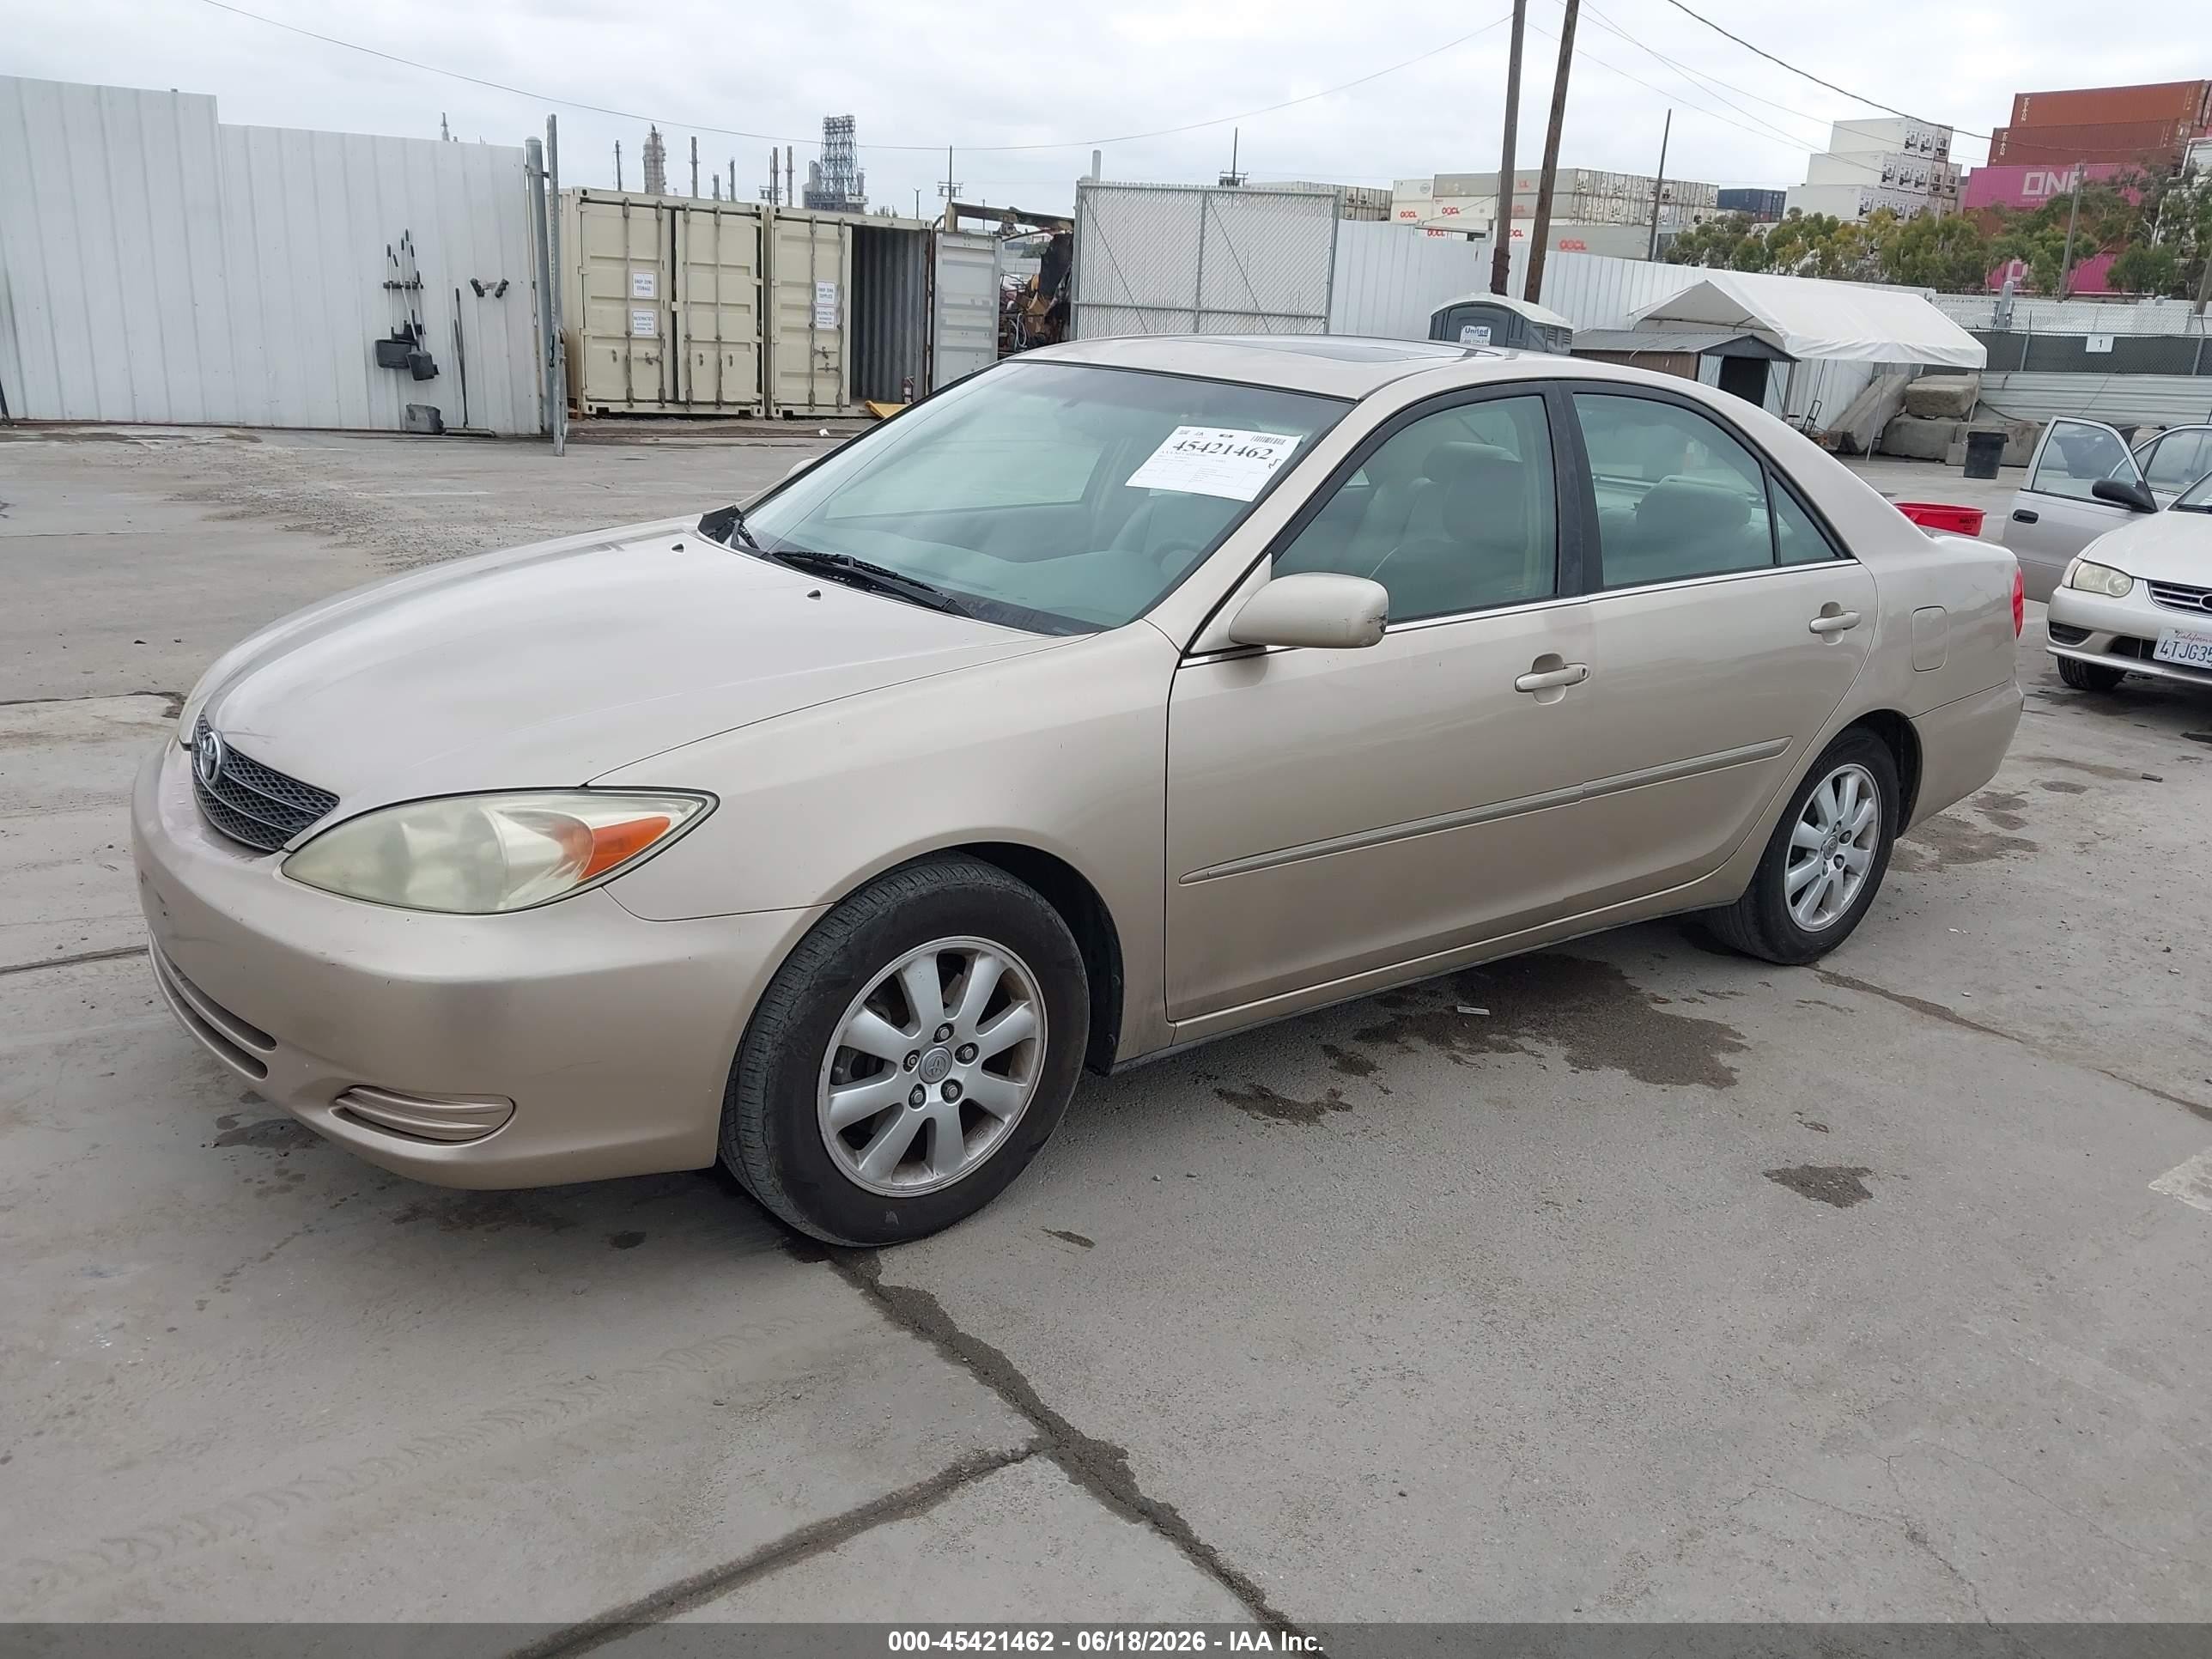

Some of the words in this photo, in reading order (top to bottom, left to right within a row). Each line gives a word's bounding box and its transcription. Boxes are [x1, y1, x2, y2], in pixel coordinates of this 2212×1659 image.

[1559, 240, 1586, 251] OOCL
[2098, 339, 2103, 348] 1
[1172, 441, 1273, 459] 45421462
